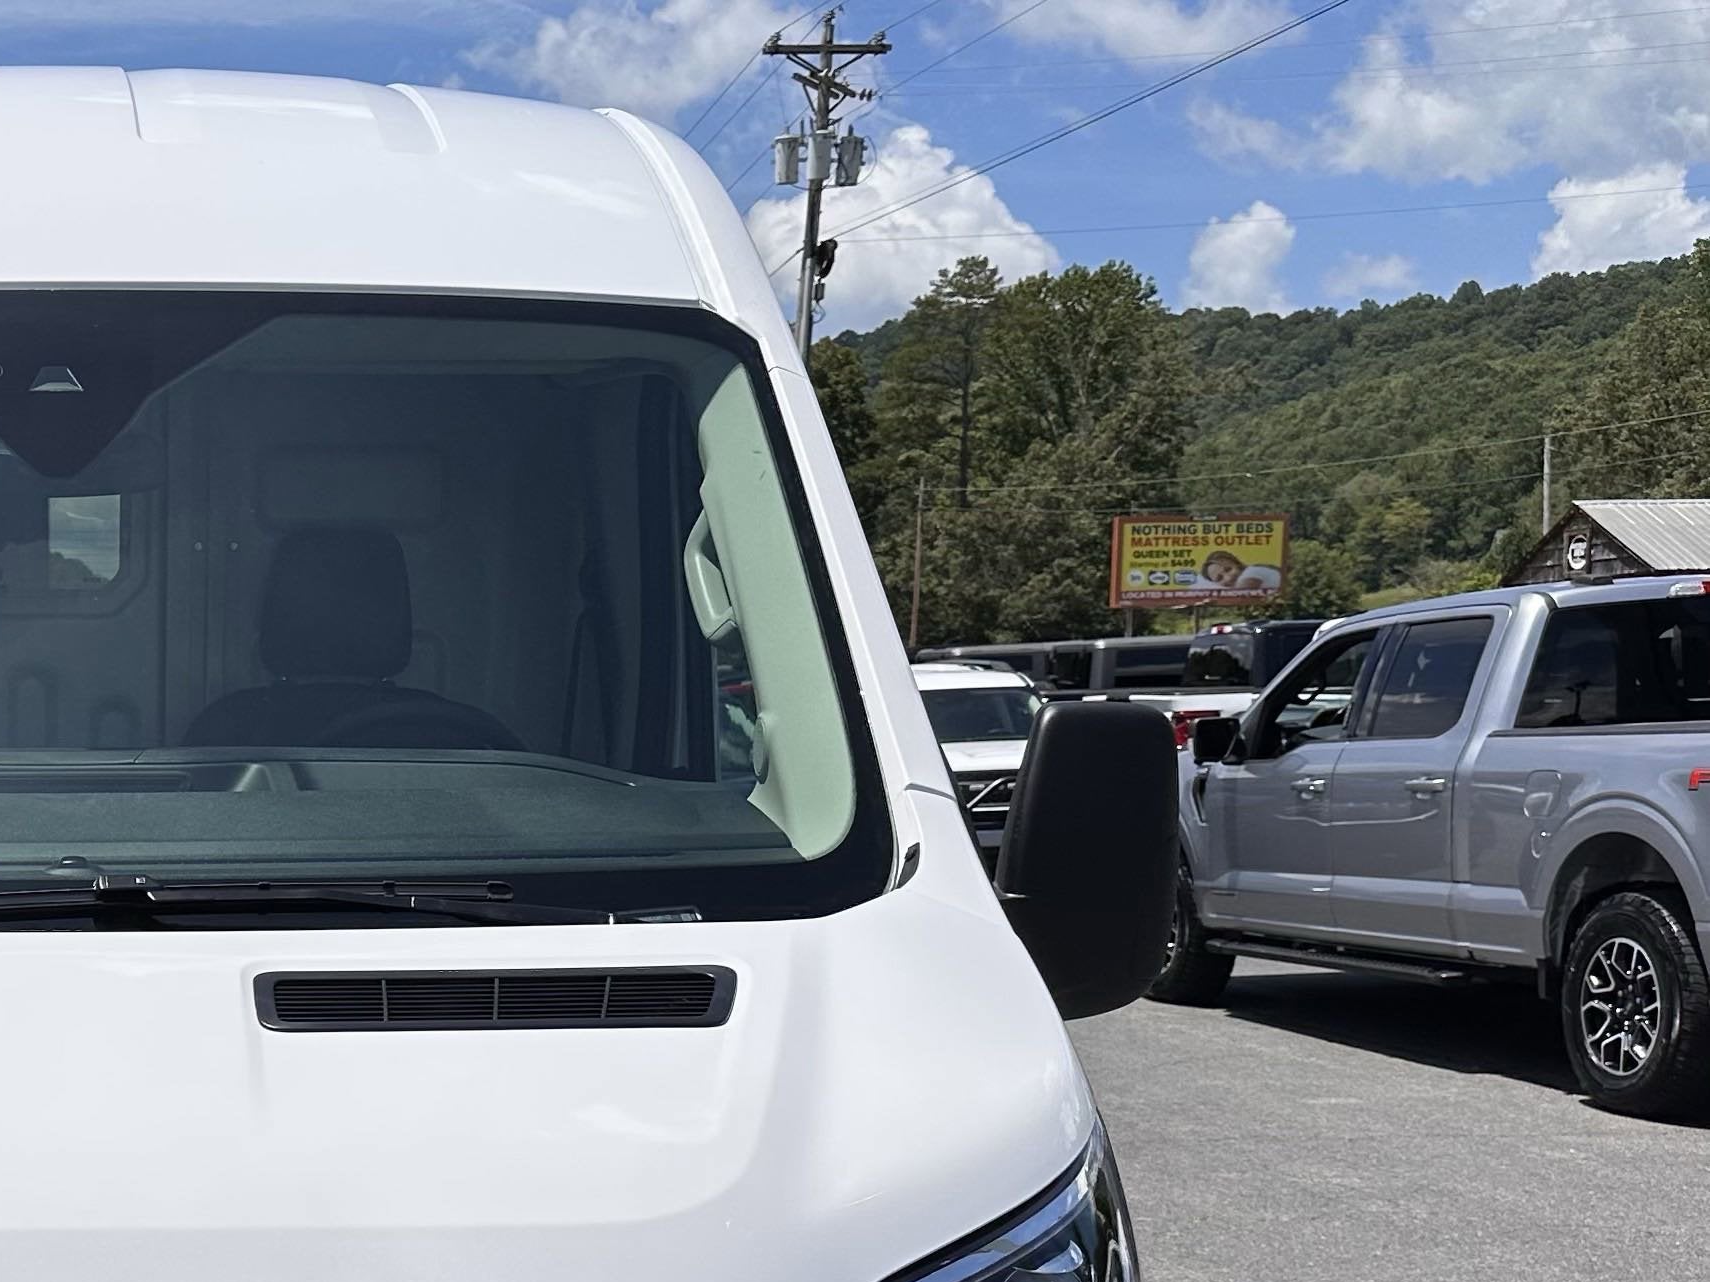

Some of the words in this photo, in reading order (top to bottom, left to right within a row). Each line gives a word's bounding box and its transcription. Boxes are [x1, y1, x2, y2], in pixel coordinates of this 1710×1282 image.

[1131, 524, 1197, 535] NOTHING
[1202, 524, 1230, 535] BUT
[1235, 523, 1274, 534] BEDS
[1131, 535, 1209, 547] MATTRESS
[1214, 534, 1273, 546] OUTLET
[1132, 549, 1170, 559] QUEEN
[1172, 549, 1192, 558] SET
[1121, 591, 1163, 600] LOCATED
